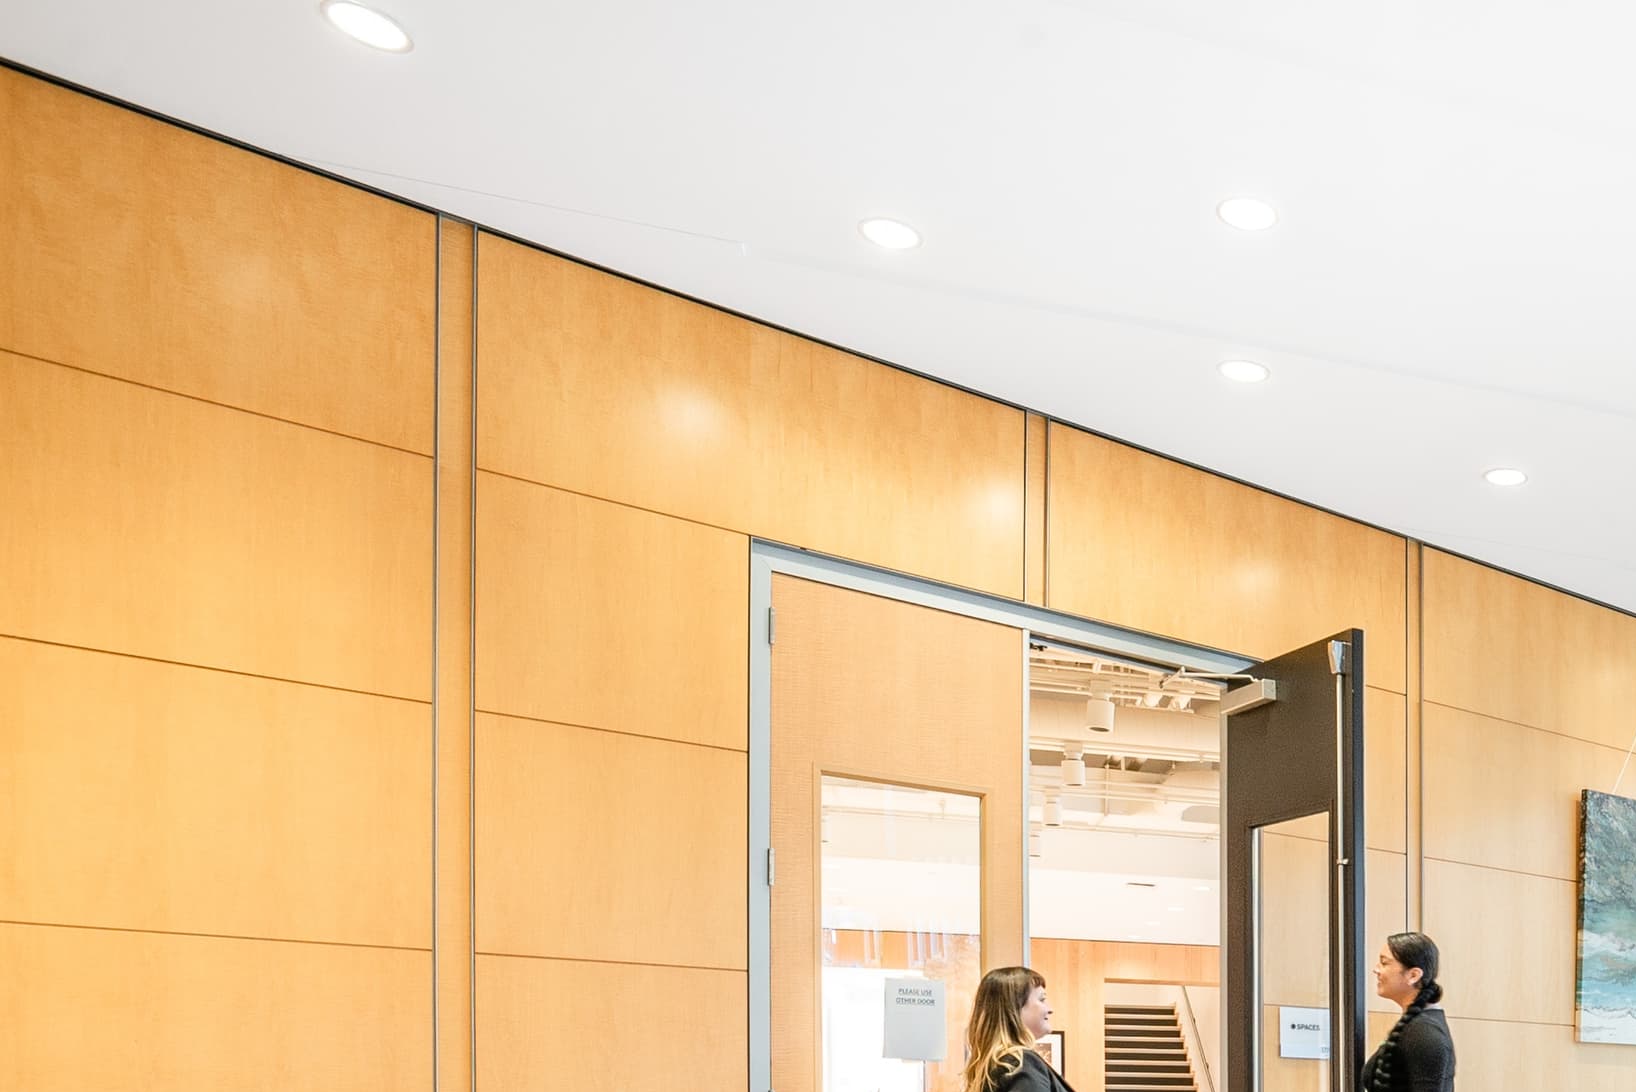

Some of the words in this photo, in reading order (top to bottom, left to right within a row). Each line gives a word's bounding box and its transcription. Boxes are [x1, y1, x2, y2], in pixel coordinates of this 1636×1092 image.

[898, 988, 919, 996] PLEASE
[921, 989, 933, 997] USE
[896, 997, 916, 1005] OTHER
[917, 998, 936, 1006] DOOR
[1297, 1023, 1320, 1031] SPACES
